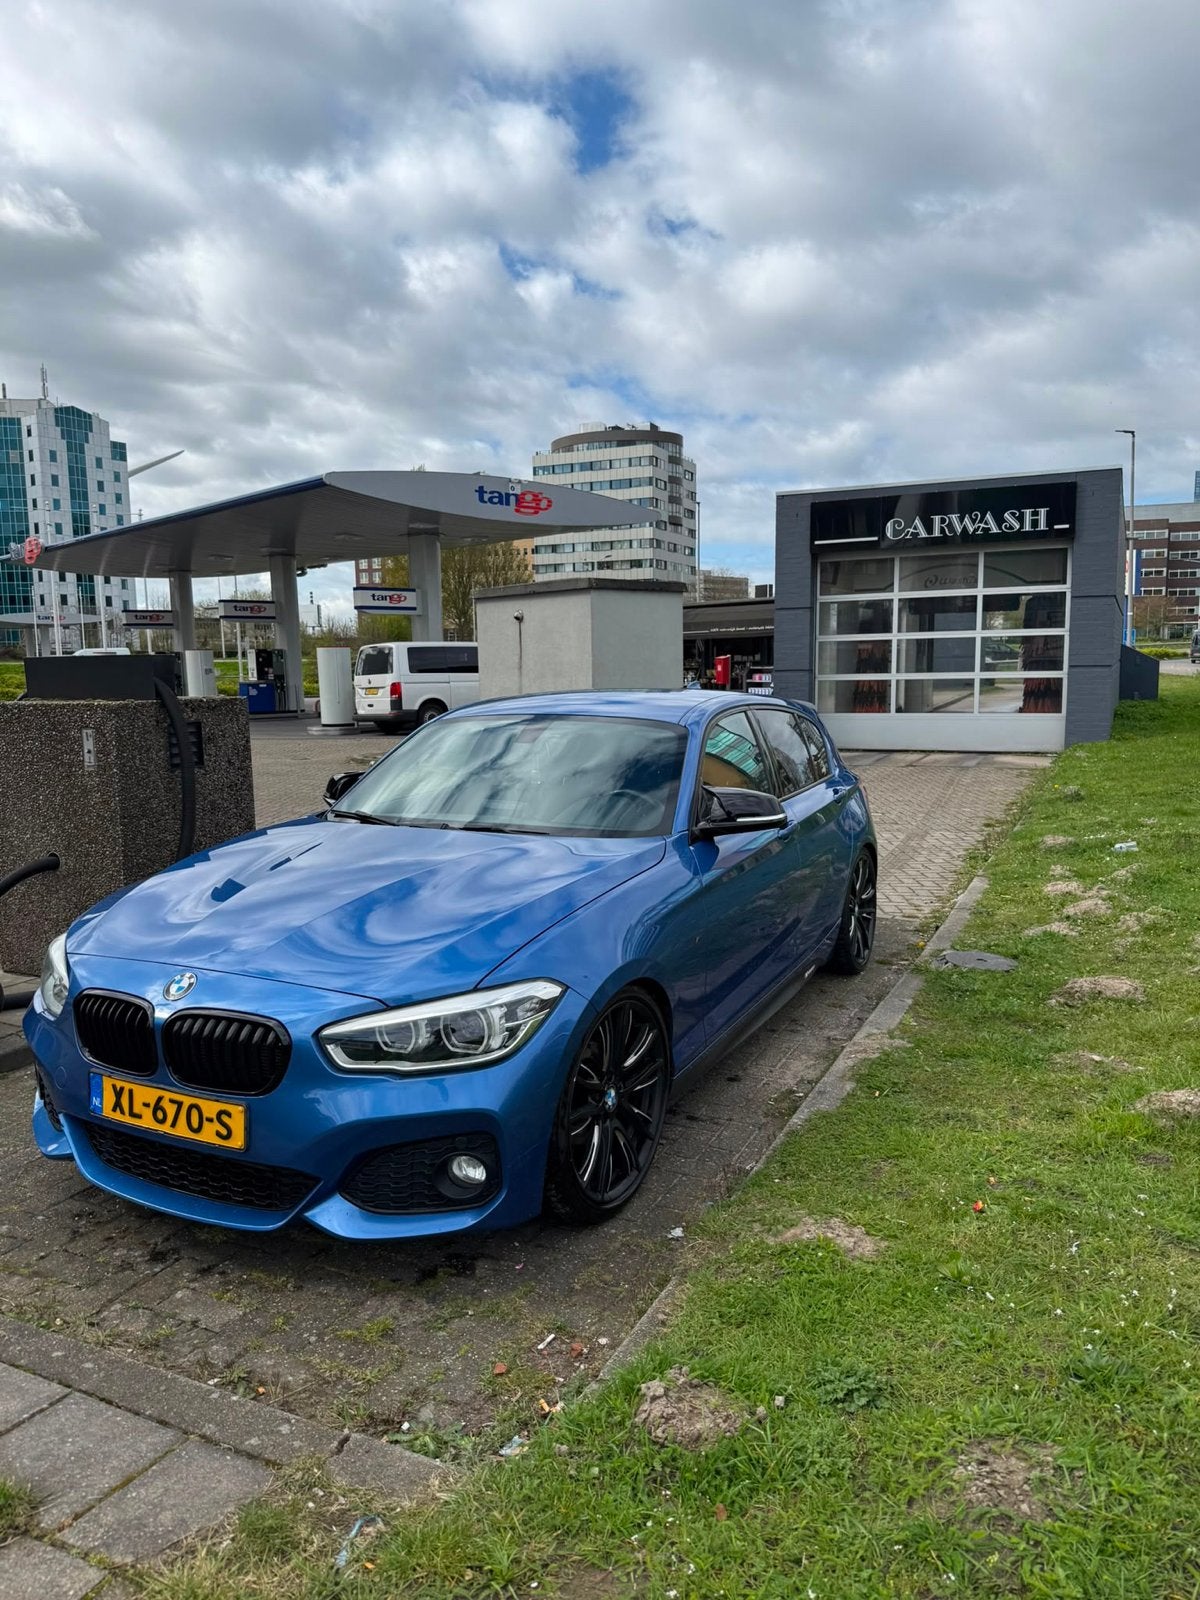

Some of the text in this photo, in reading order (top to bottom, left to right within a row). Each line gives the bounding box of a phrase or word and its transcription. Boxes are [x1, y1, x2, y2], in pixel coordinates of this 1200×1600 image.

[474, 485, 553, 516] tango
[885, 507, 1050, 540] CARWASH
[233, 604, 267, 615] tango
[370, 593, 407, 605] tango
[92, 1096, 102, 1107] NL
[111, 1083, 233, 1141] XL-670-S
